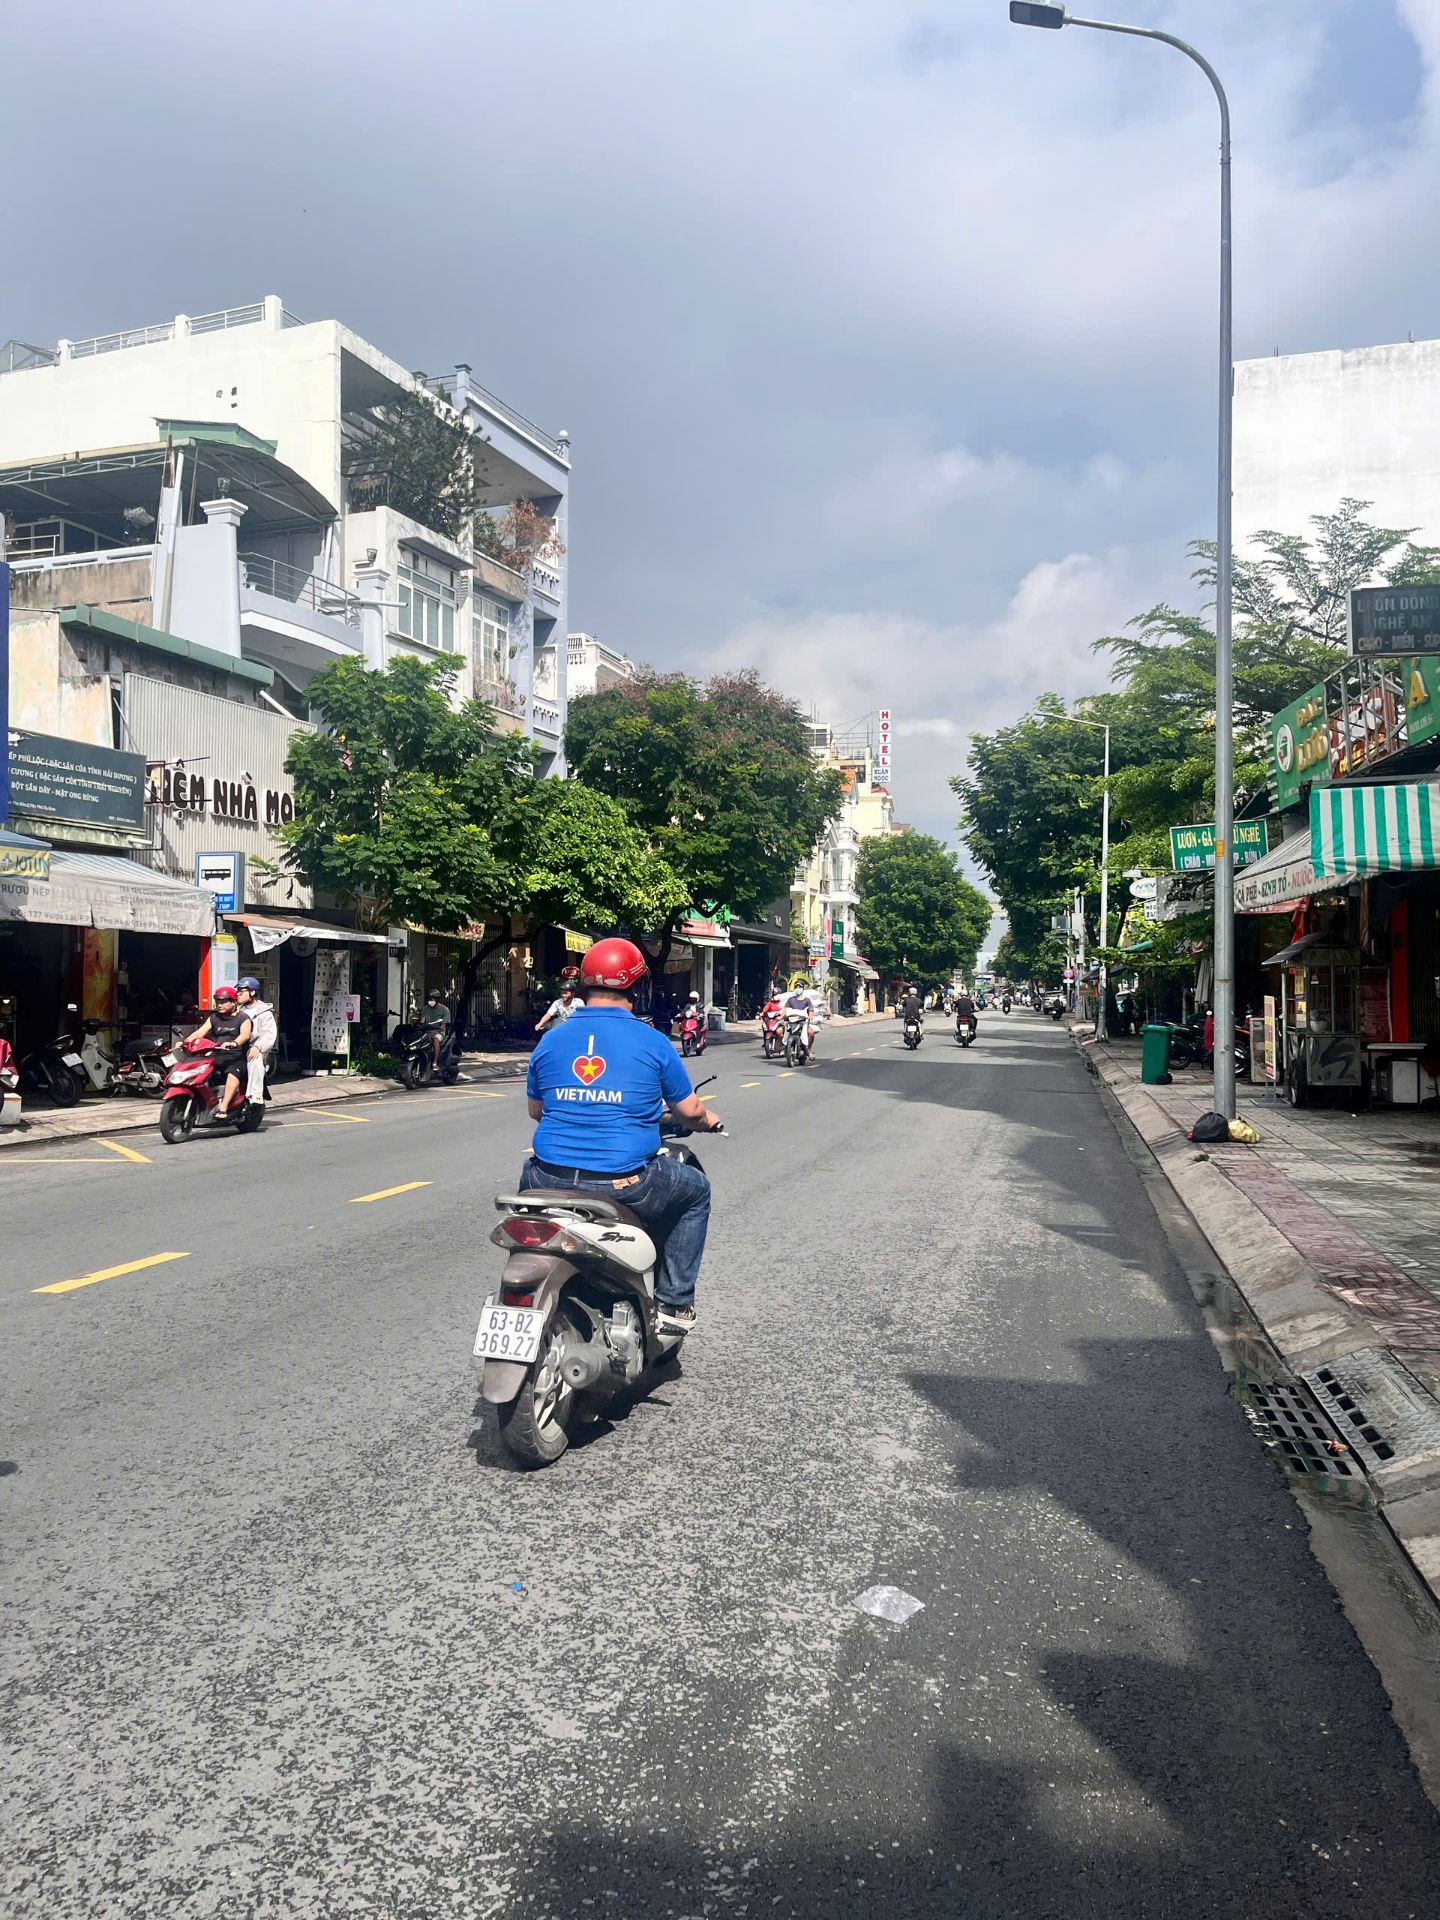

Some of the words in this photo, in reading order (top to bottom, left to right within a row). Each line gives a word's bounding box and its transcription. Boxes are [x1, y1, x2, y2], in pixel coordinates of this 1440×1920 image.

[881, 711, 889, 765] HOTEL
[213, 771, 258, 821] NHÀ
[1201, 826, 1213, 847] GÀ
[587, 1035, 594, 1055] I
[556, 1088, 622, 1102] VIETNAM
[489, 1311, 534, 1334] 63-B2
[478, 1331, 536, 1358] 369.27
